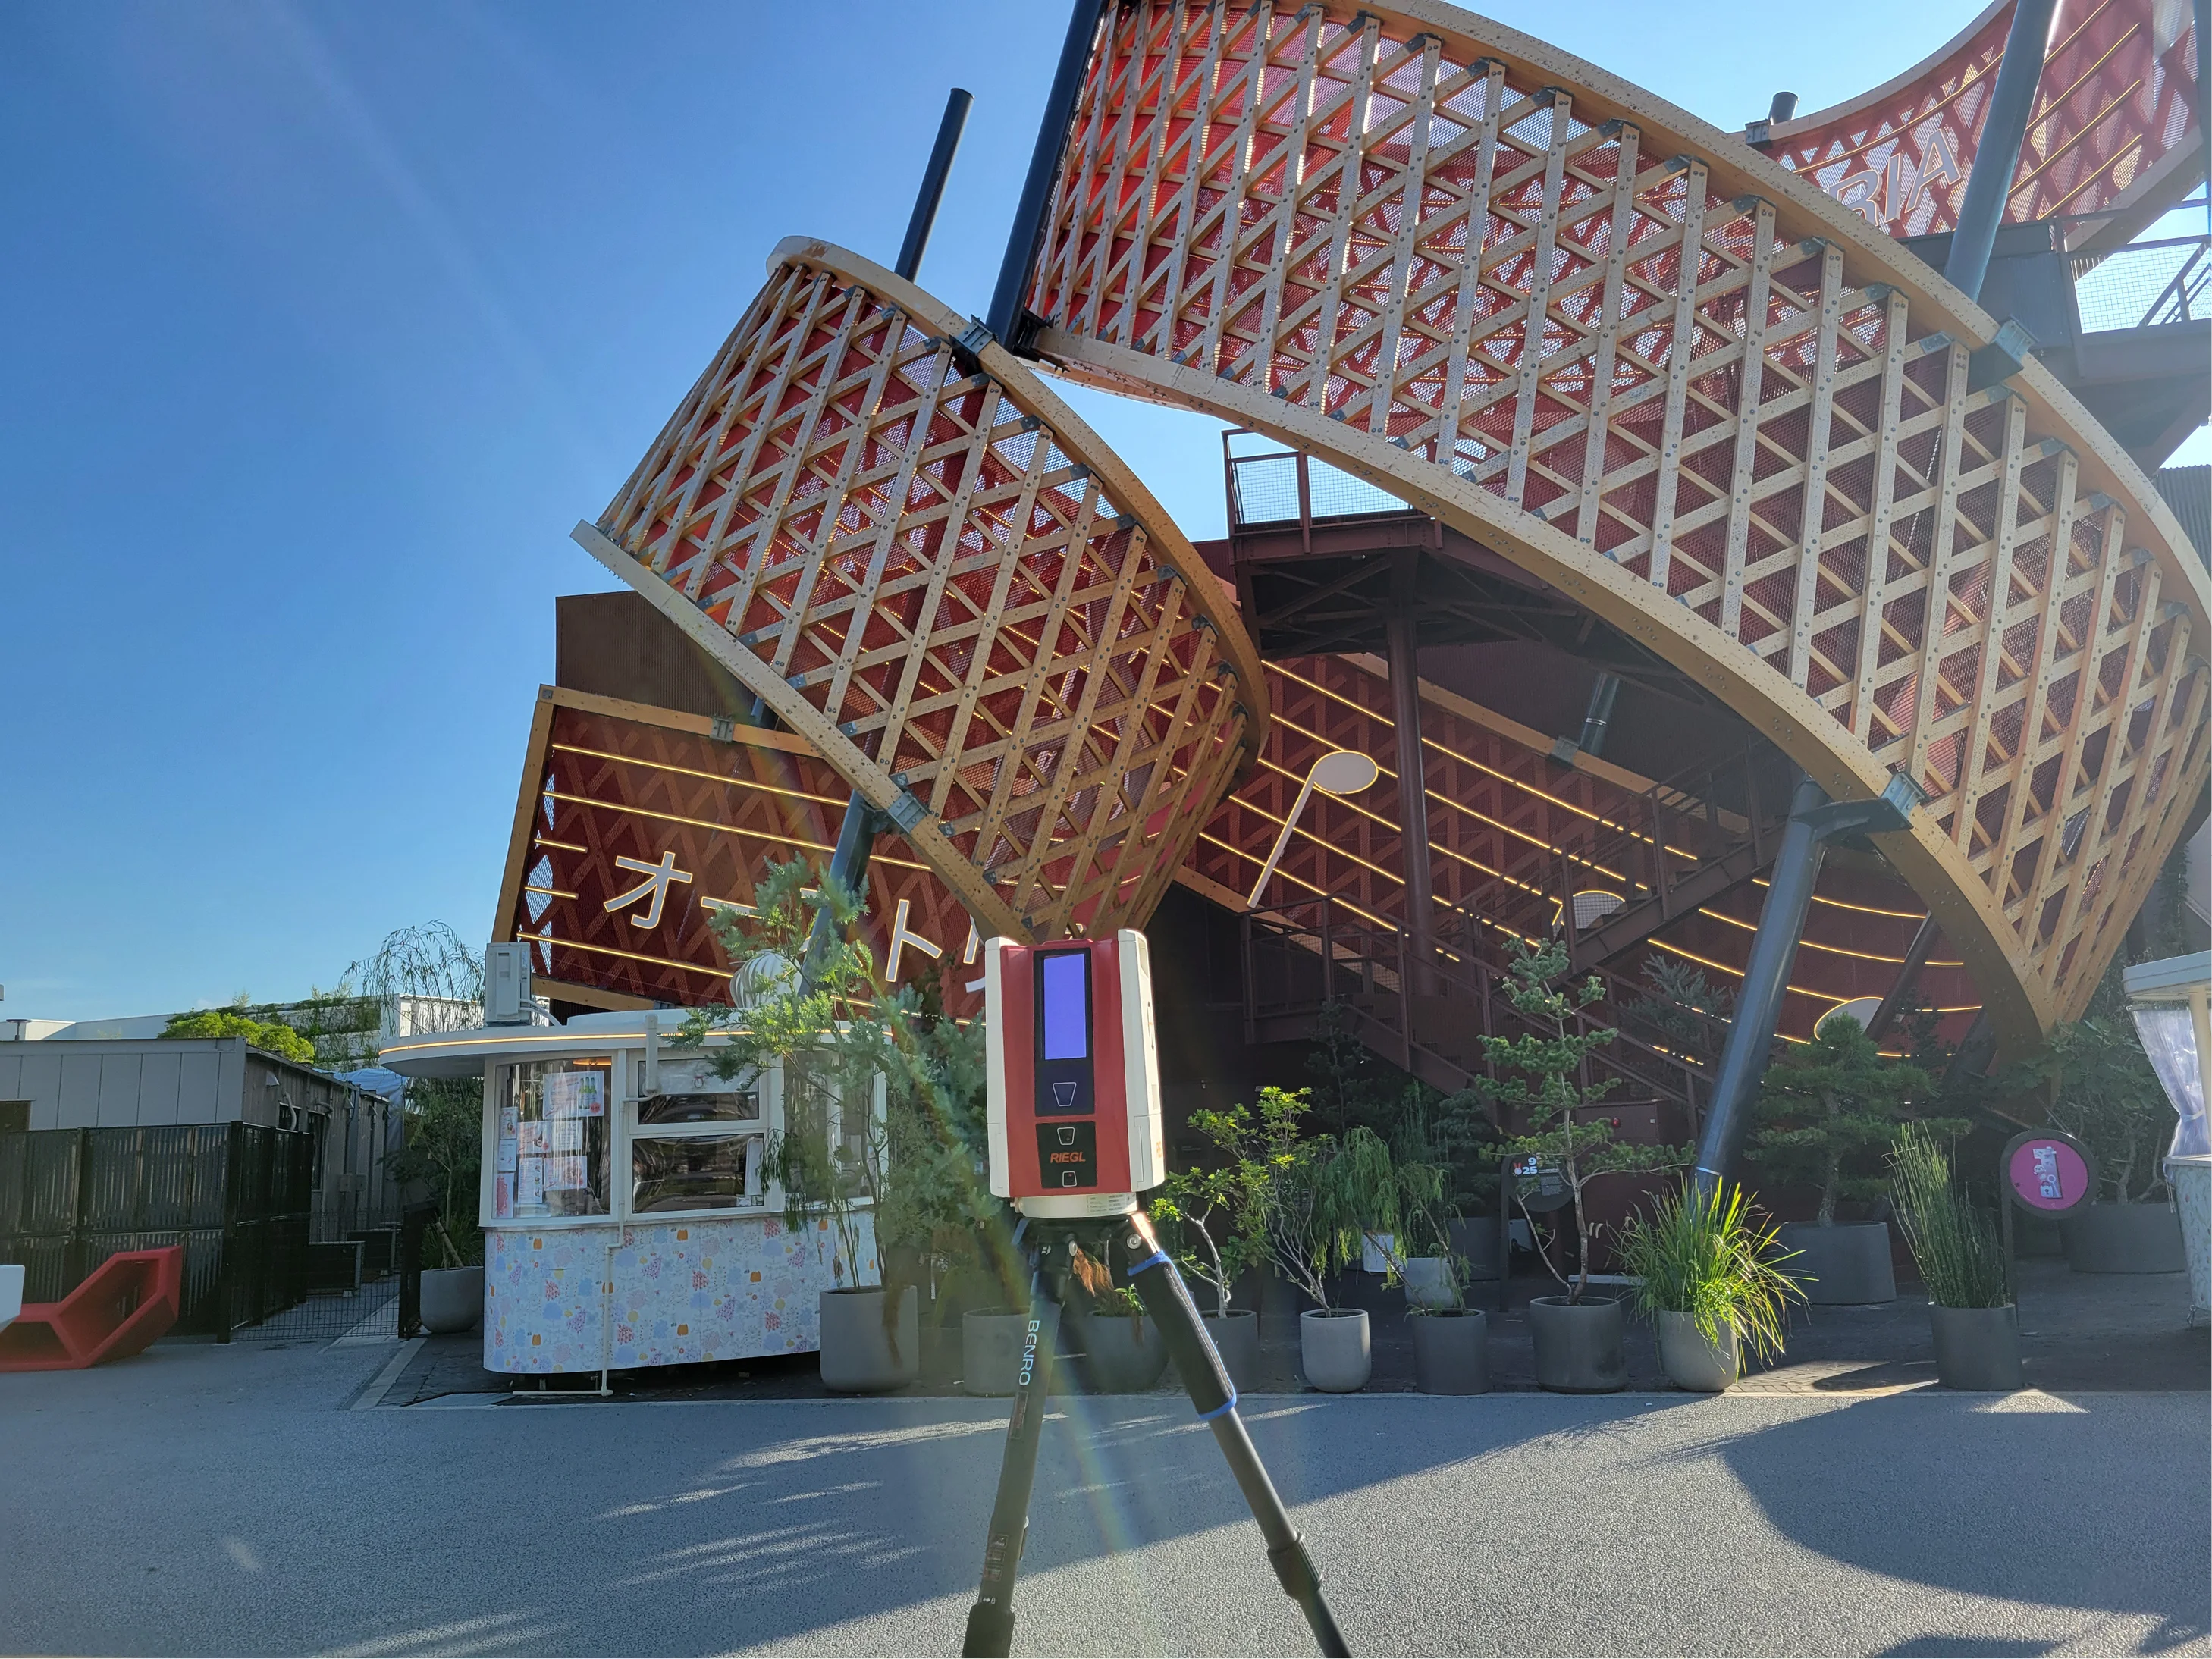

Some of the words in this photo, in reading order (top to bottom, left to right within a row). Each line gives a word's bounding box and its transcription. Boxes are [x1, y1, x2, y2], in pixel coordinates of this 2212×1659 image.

[1050, 1152, 1086, 1163] RIEGL
[1523, 1166, 1538, 1174] 25
[1018, 1319, 1040, 1387] BENRO
